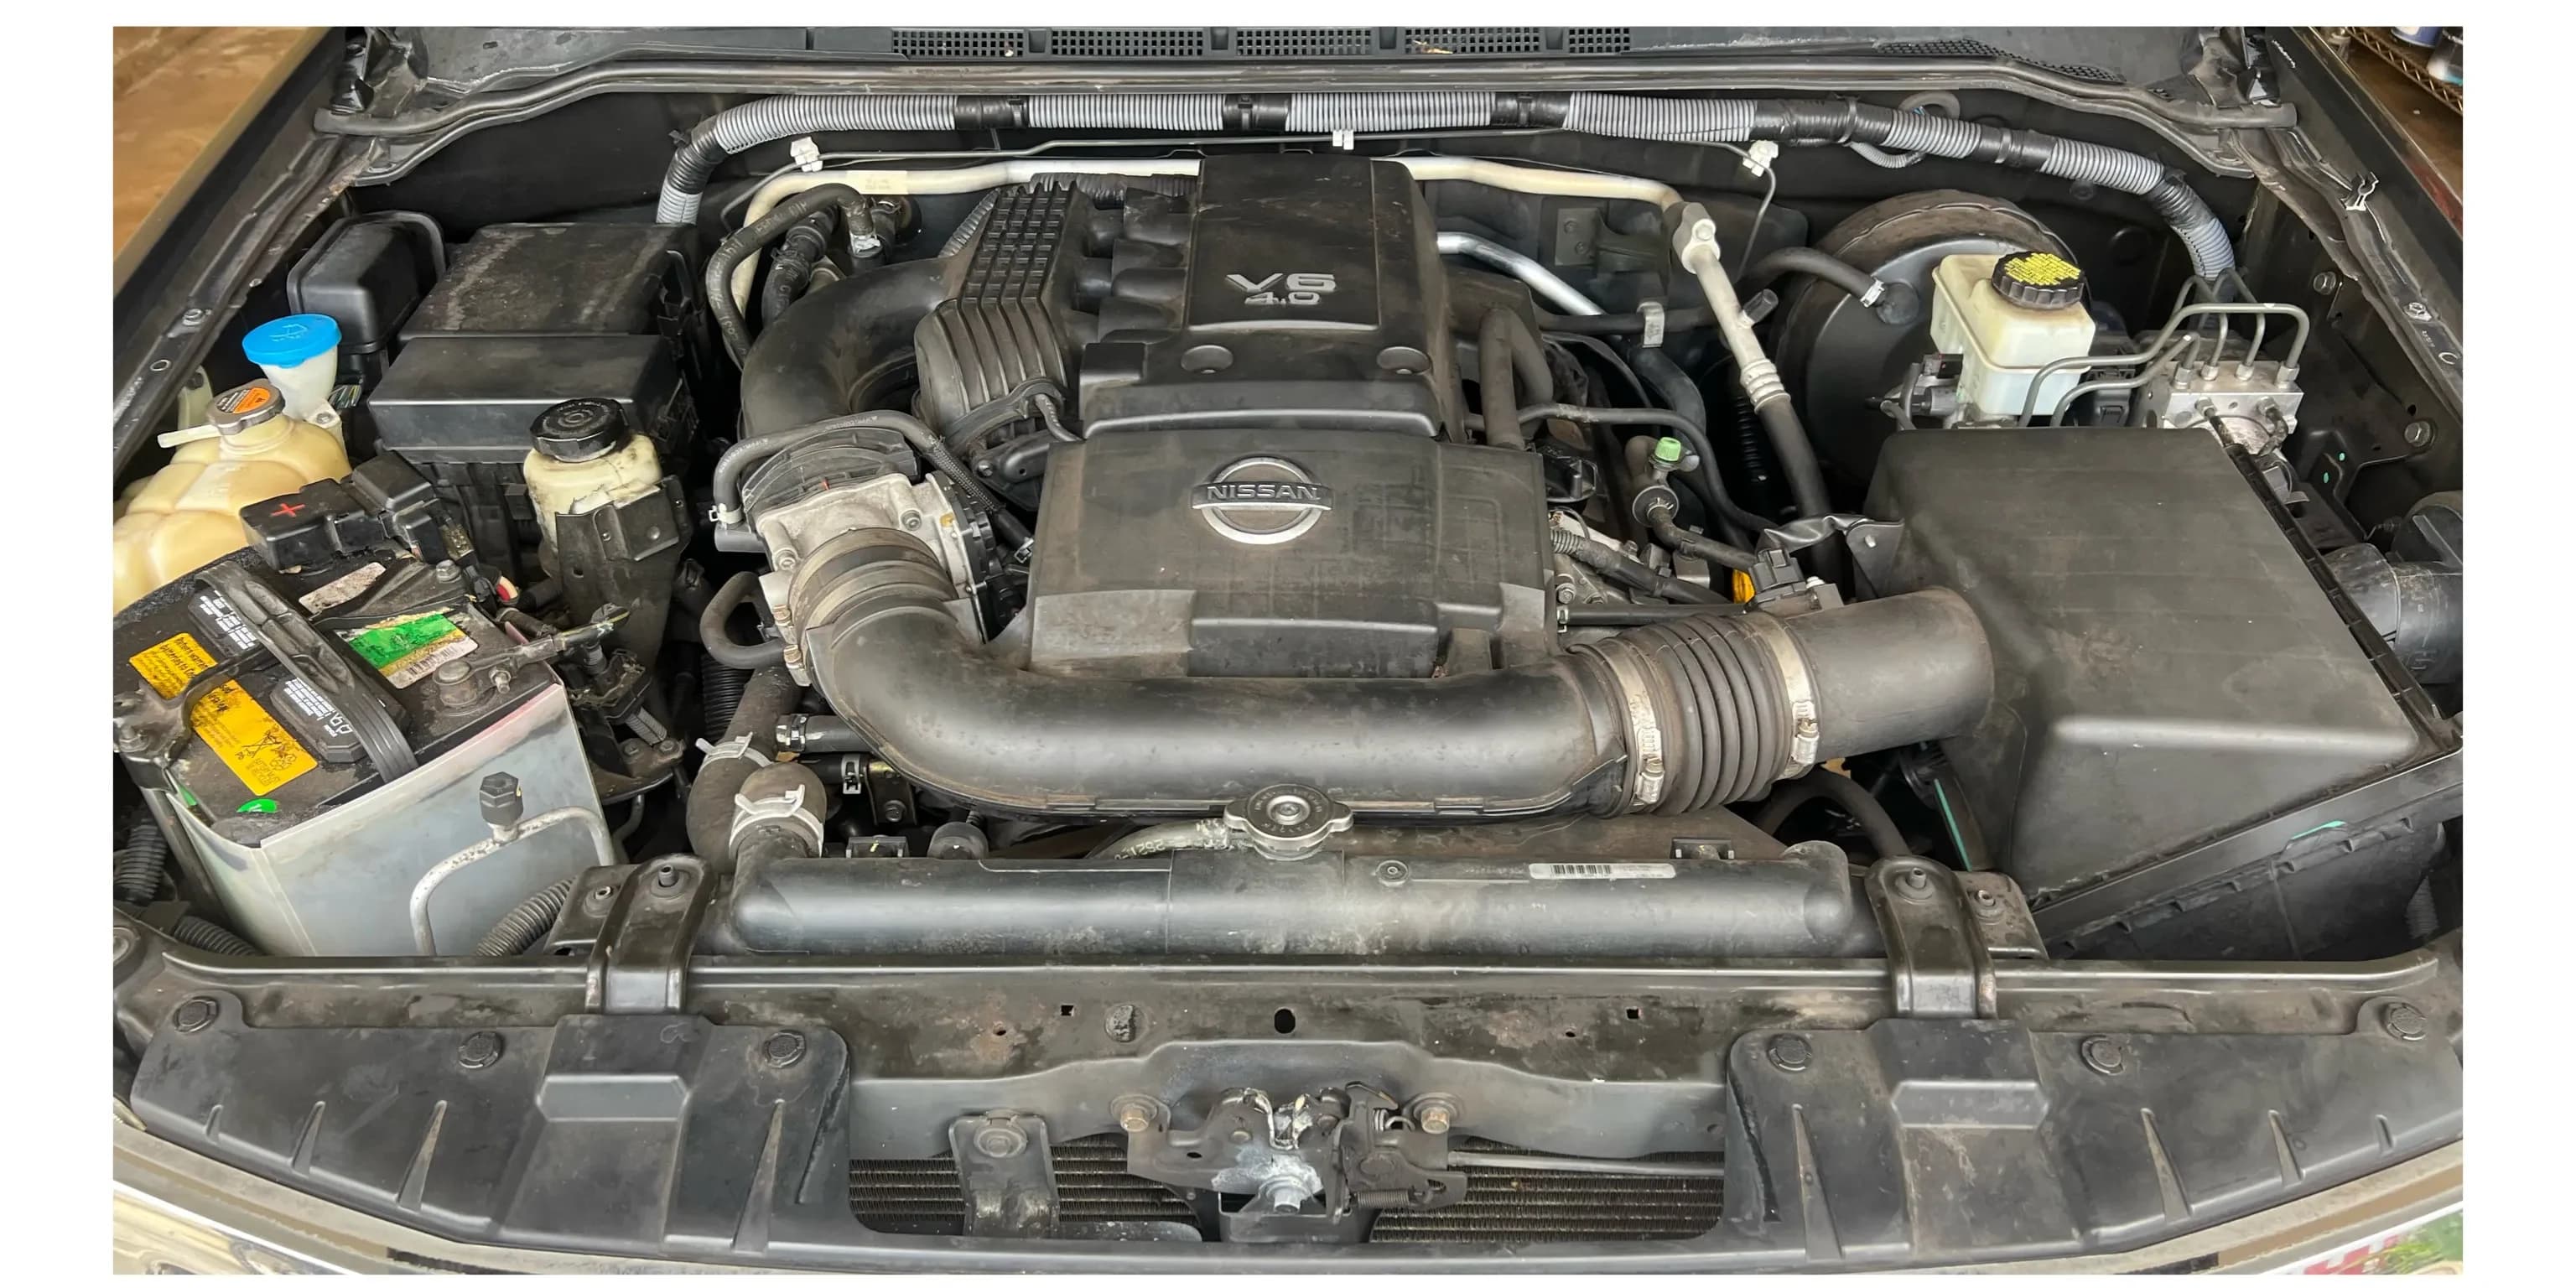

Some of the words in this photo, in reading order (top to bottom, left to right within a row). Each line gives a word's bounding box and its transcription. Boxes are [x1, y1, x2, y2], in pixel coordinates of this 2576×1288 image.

[1225, 273, 1337, 292] V6
[1244, 291, 1322, 305] 4.0
[1206, 484, 1322, 501] NISSAN
